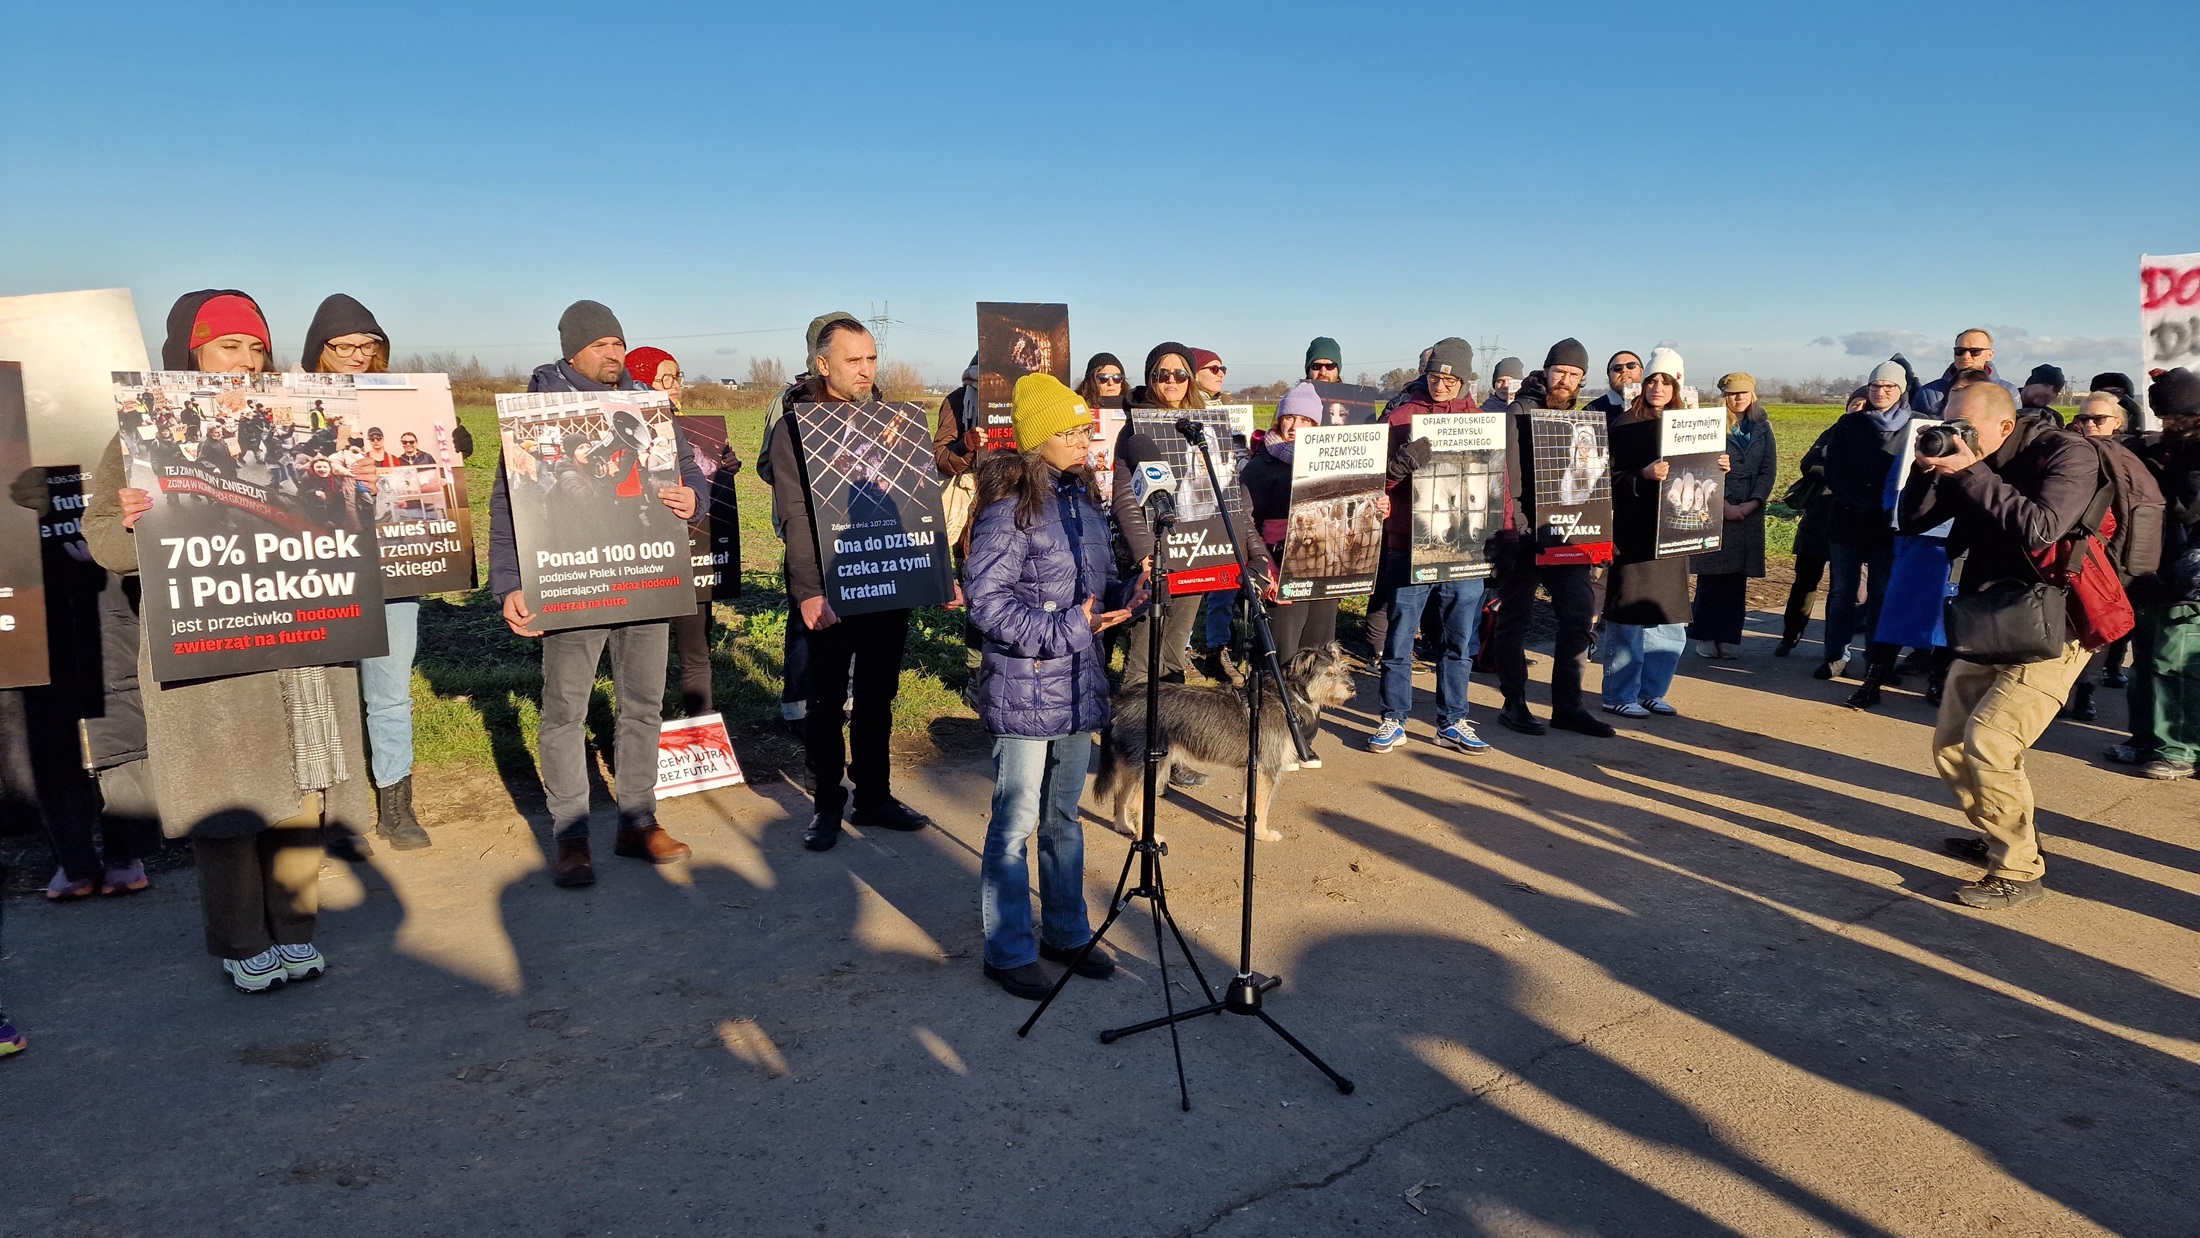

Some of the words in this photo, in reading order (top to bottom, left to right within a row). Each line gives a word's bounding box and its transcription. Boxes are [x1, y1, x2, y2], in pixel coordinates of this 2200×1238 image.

[1423, 417, 1451, 426] OFIARY
[1453, 416, 1496, 425] POLSKIEGO
[1671, 416, 1721, 432] Zatrzymajmy
[988, 428, 1002, 438] NIE
[1305, 433, 1335, 445] OFIARY
[1337, 431, 1381, 443] POLSKIEGO
[1437, 427, 1483, 436] PRZEMYSŁU
[1674, 431, 1696, 444] fermy
[1697, 430, 1719, 442] norek
[1318, 445, 1367, 458] PRZEMYSŁU
[1308, 458, 1374, 472] FUTRZARSKIEGO
[167, 479, 190, 490] ZGINĄ
[220, 478, 268, 504] ZWIERZĄT
[1549, 514, 1575, 524] CZAS
[383, 521, 425, 538] wieś
[429, 519, 457, 534] nie
[1550, 526, 1566, 535] NA
[1567, 525, 1602, 535] ZAKAZ
[833, 538, 864, 554] Ona
[864, 536, 882, 552] do
[884, 530, 935, 550] DZISIAJ
[1166, 532, 1200, 545] CZAS
[160, 535, 246, 570] 70%
[254, 529, 361, 564] Polek
[536, 547, 598, 568] Ponad
[602, 543, 636, 563] 100
[639, 541, 675, 560] 000
[1168, 546, 1189, 558] NA
[1191, 543, 1235, 557] ZAKAZ
[539, 570, 587, 584] podpisów
[589, 568, 616, 579] Polek
[624, 564, 664, 576] Polaków
[837, 560, 880, 578] czeka
[881, 559, 898, 573] za
[898, 553, 932, 572] tymi
[168, 578, 180, 610] i
[191, 568, 356, 608] Polaków
[540, 583, 610, 600] popierających
[611, 579, 640, 592] zakaz
[641, 576, 680, 589] hodowli
[840, 579, 897, 601] kratami
[542, 600, 586, 614] zwierząt
[588, 599, 600, 609] na
[602, 596, 628, 608] futra
[171, 618, 203, 636] jest
[207, 611, 293, 633] przeciwko
[295, 603, 361, 623] hodowli
[173, 634, 251, 655] zwierząt
[254, 632, 277, 647] na
[278, 626, 327, 645] futro!
[660, 770, 682, 783] BEZ
[683, 764, 718, 777] FUTRA
